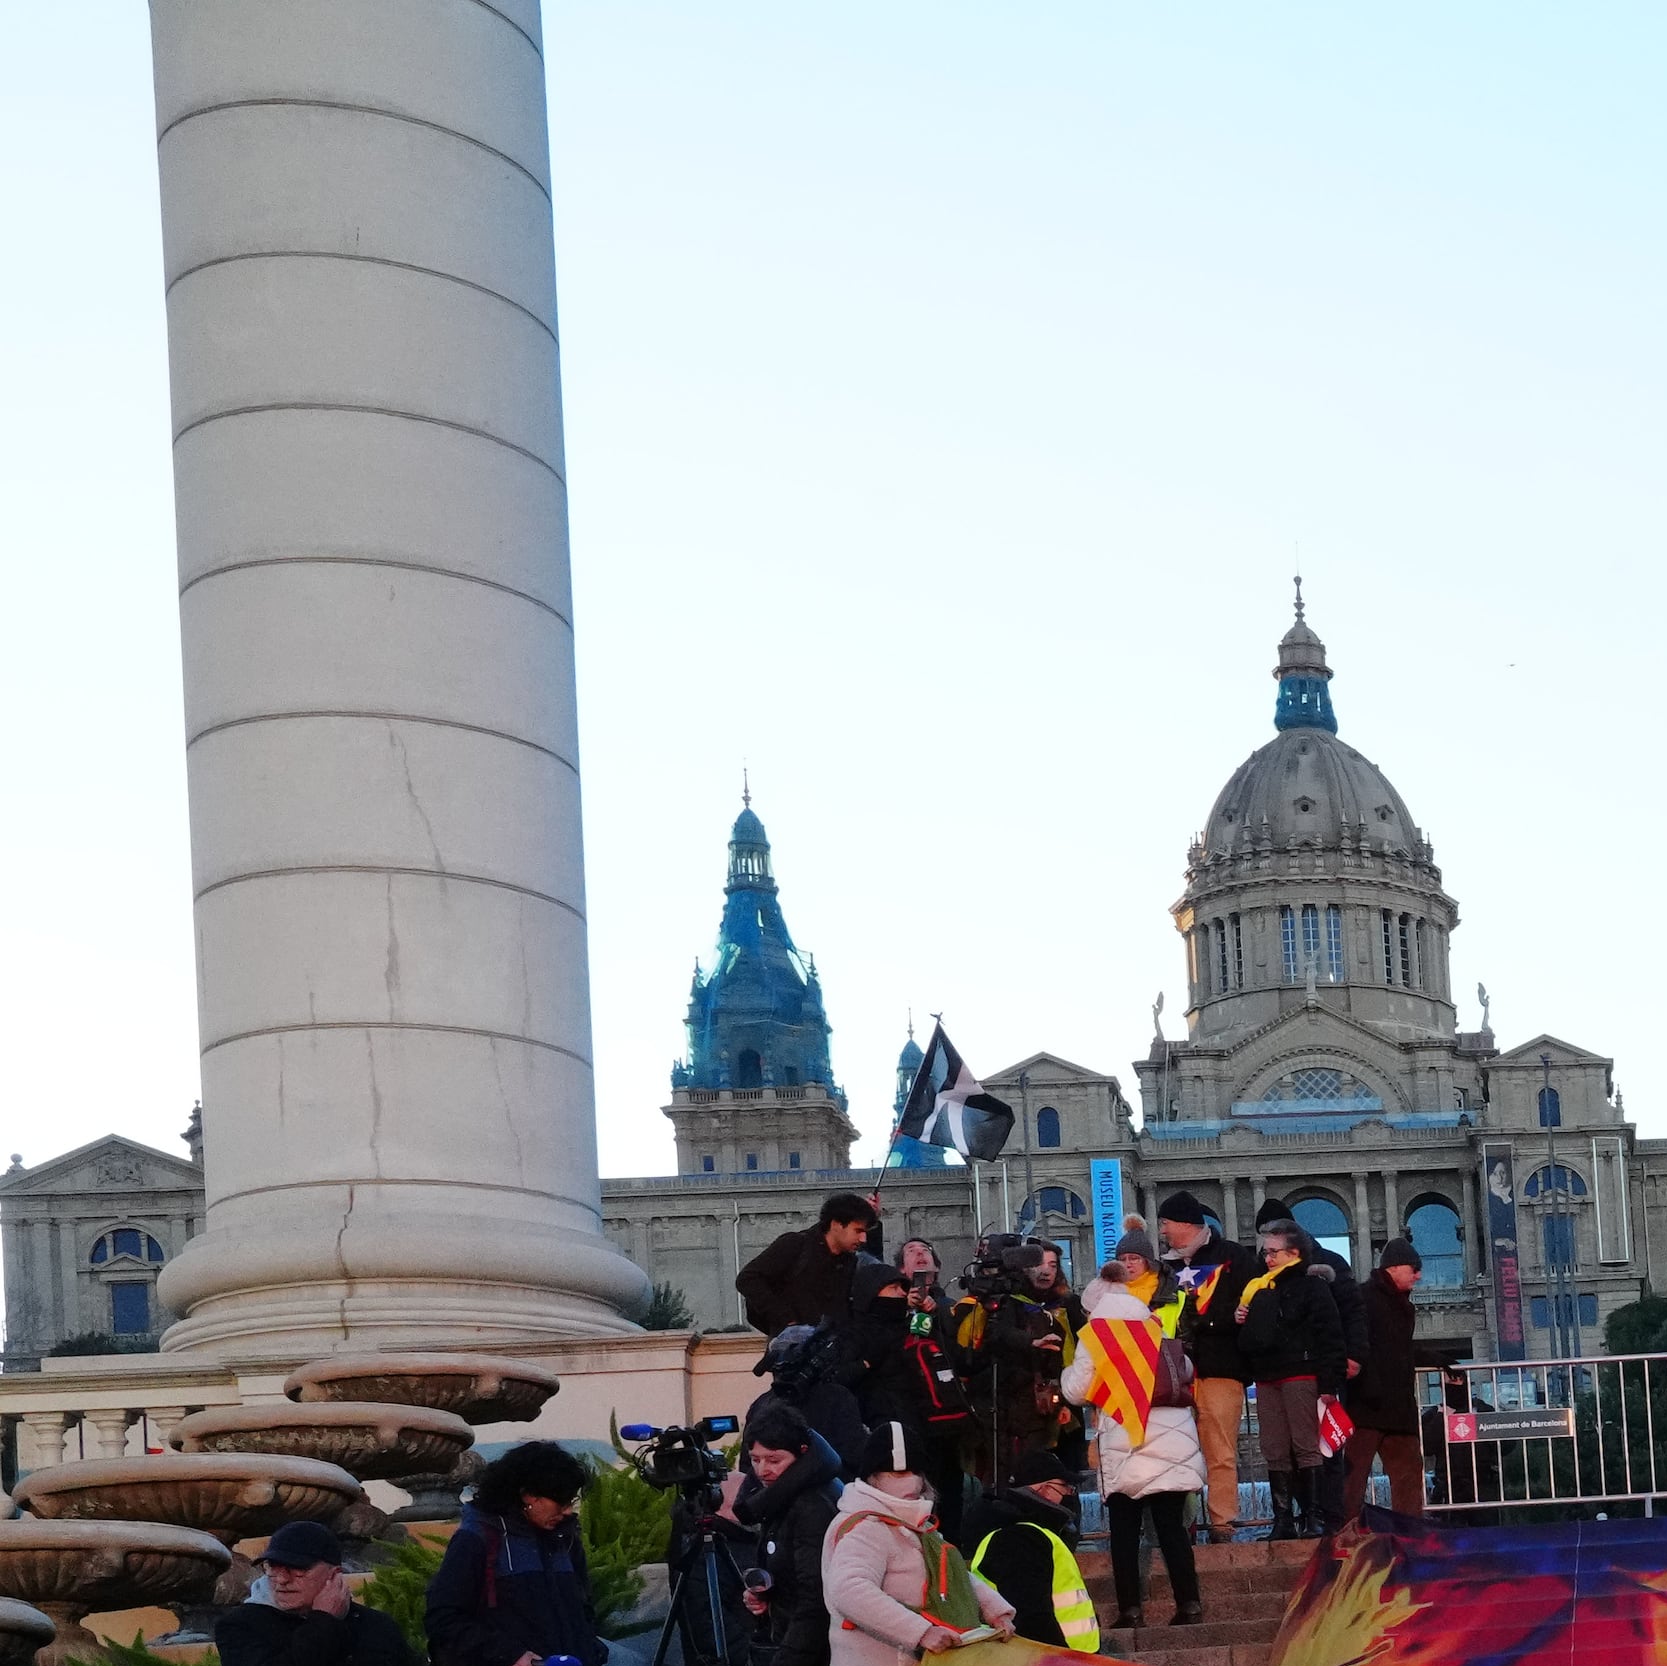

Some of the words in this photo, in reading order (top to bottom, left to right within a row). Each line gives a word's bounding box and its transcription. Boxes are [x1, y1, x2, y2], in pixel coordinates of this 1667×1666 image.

[1098, 1171, 1114, 1208] MUSEU
[1101, 1212, 1117, 1263] NACIONA
[1478, 1423, 1520, 1431] Ajuntament
